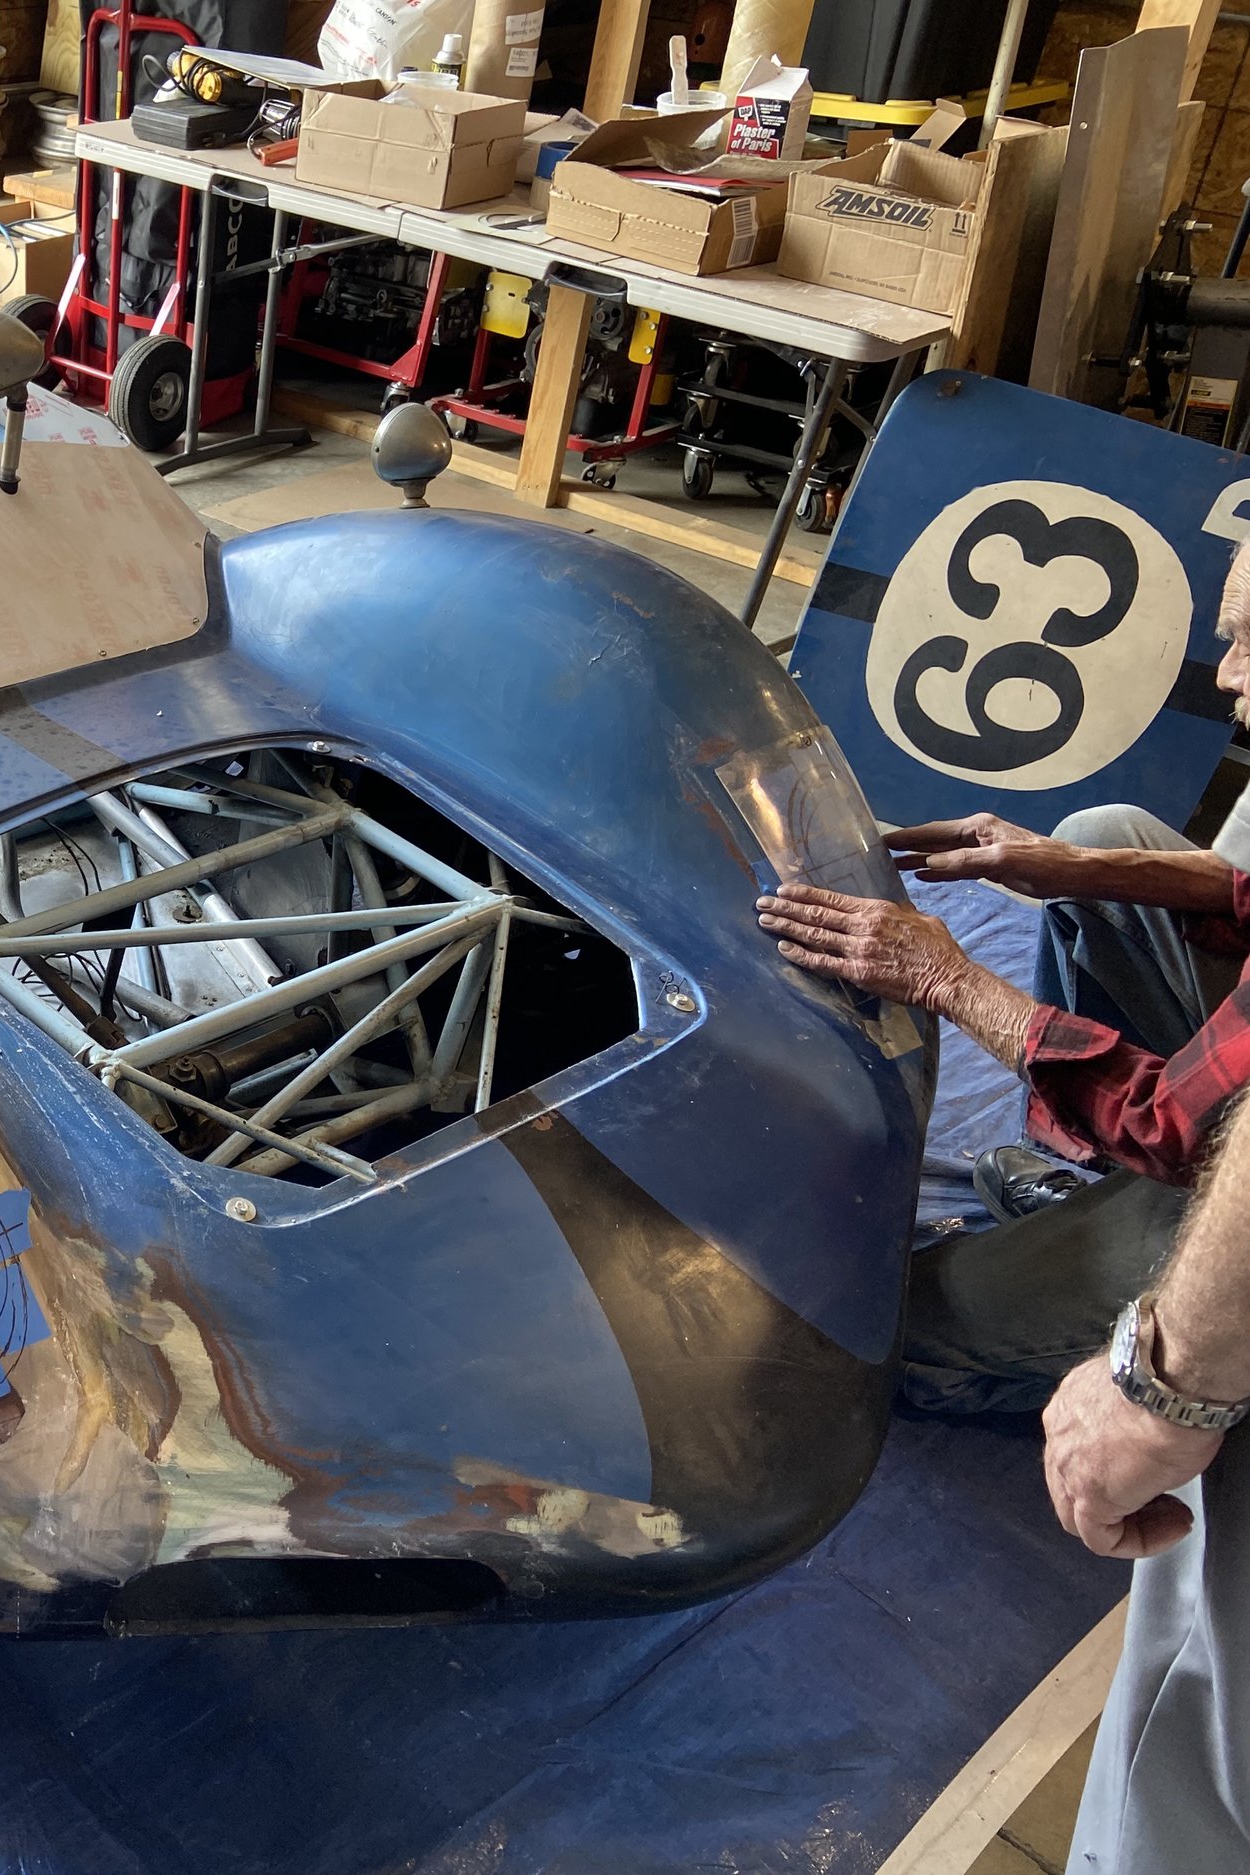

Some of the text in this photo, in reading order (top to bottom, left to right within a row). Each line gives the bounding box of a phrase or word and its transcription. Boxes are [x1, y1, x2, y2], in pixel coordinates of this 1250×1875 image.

[740, 108, 751, 116] DAP
[733, 123, 776, 139] Plaster
[731, 138, 772, 152] of Paris
[822, 188, 932, 228] AMSOIL
[893, 499, 1140, 773] 63
